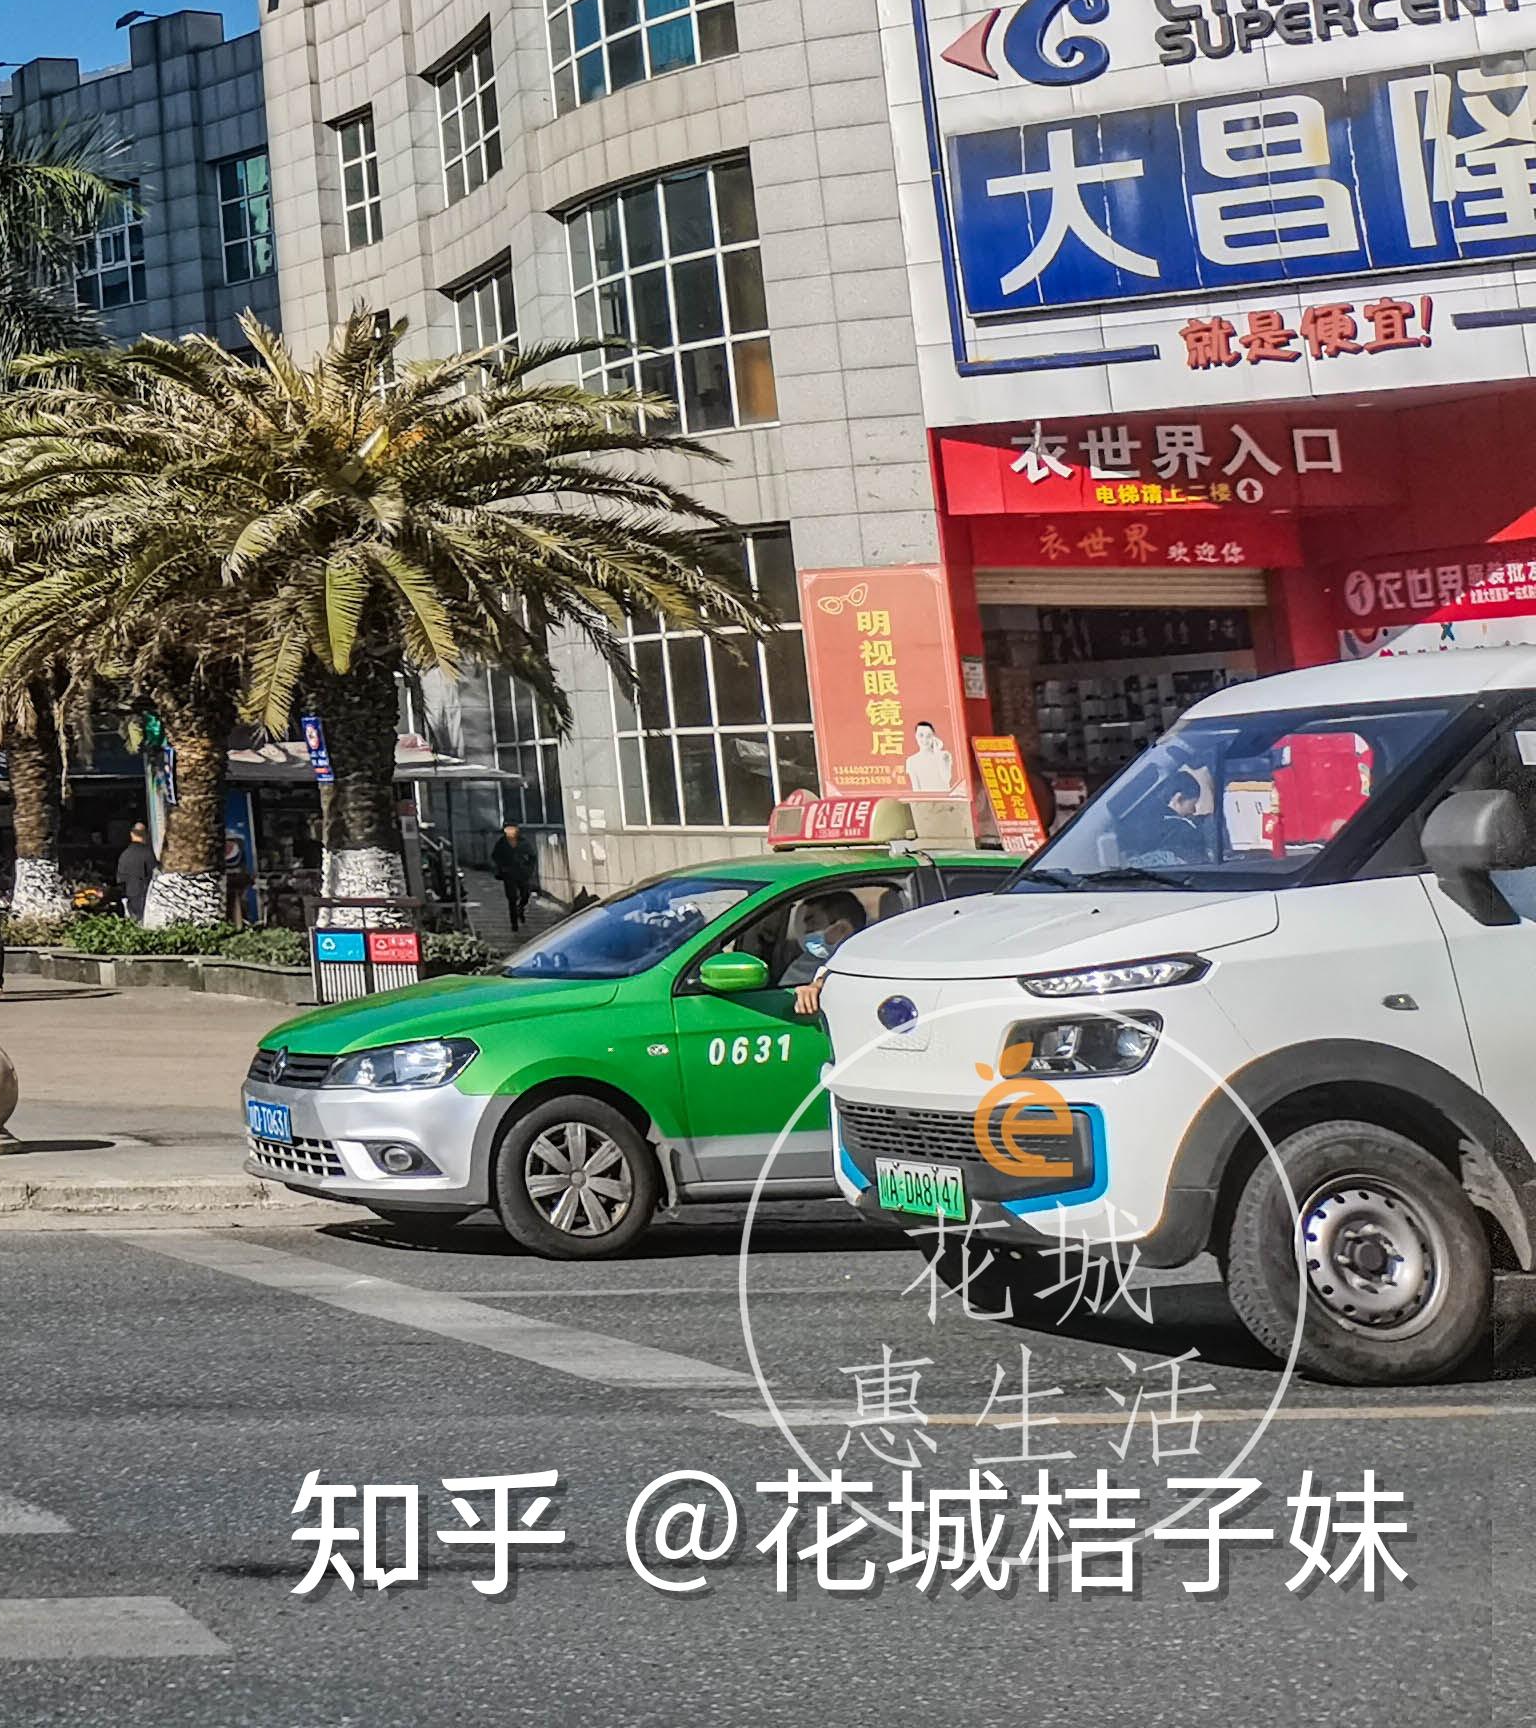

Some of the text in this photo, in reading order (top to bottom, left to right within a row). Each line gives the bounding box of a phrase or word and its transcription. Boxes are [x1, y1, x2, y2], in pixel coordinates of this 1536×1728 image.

[986, 68, 1536, 296] 大昌隆
[1010, 420, 1343, 484] 衣世界入口
[1095, 482, 1232, 506] 电梯请上二楼
[856, 610, 906, 756] 明视眼镜店
[708, 1033, 791, 1066] 0631
